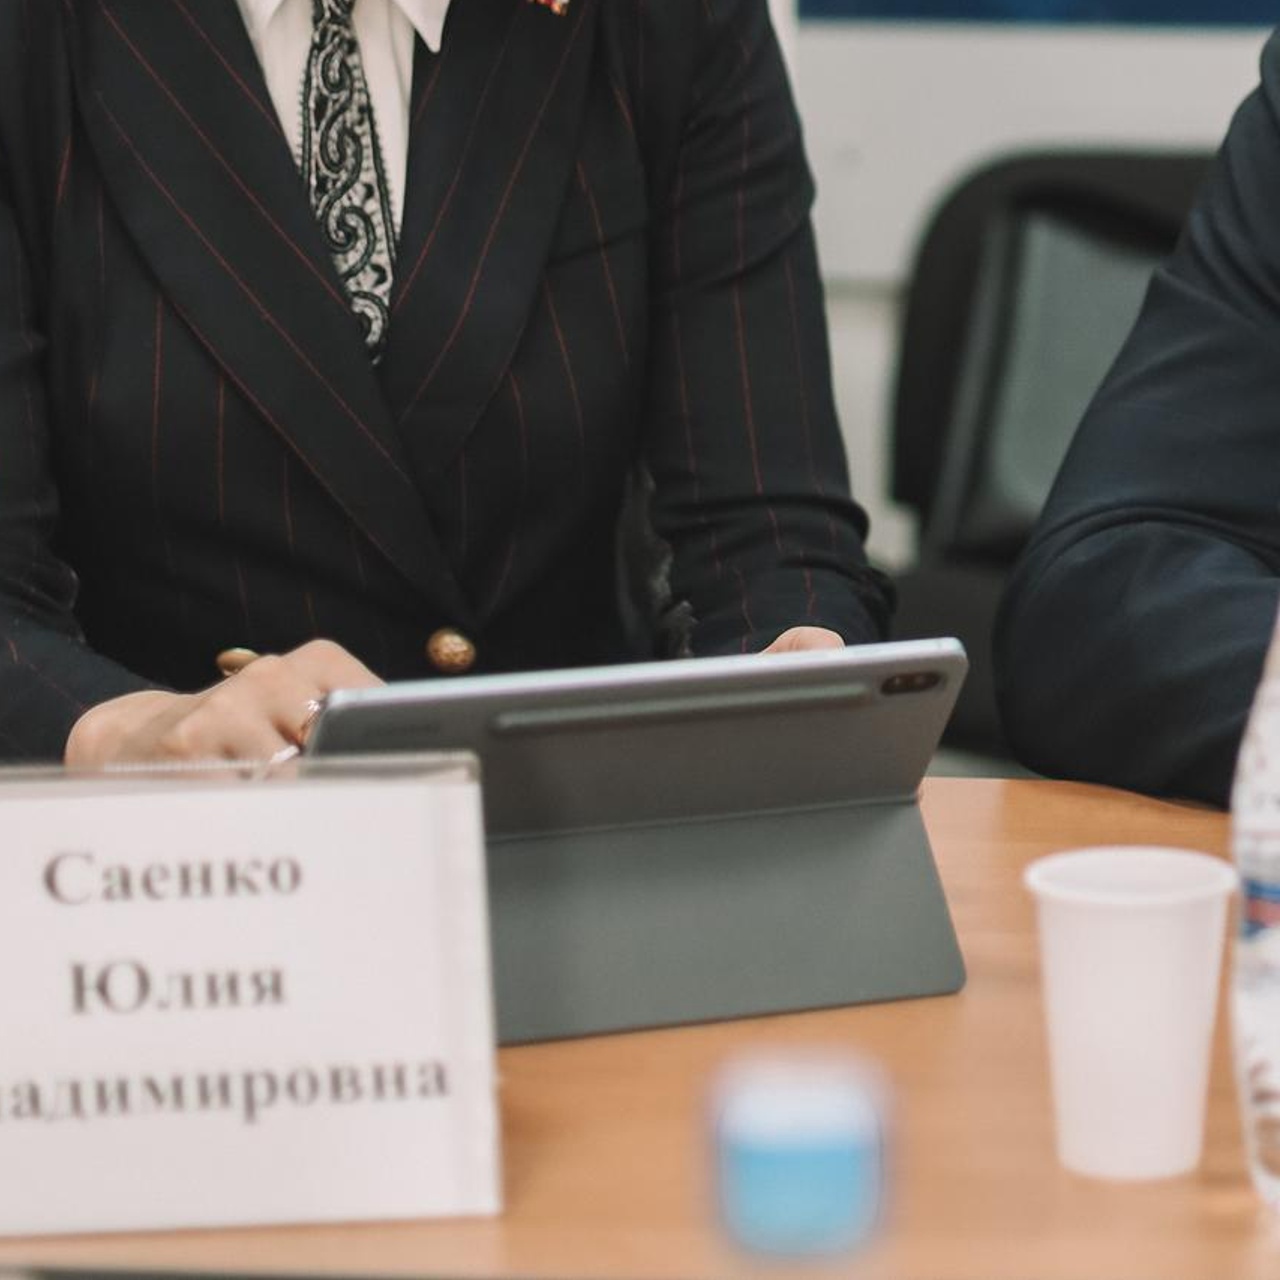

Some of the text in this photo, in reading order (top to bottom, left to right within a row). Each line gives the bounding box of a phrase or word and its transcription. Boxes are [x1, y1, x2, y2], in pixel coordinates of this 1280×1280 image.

[42, 851, 303, 904] Саенко
[68, 958, 286, 1015] Юлия
[0, 1058, 450, 1123] адимировна
